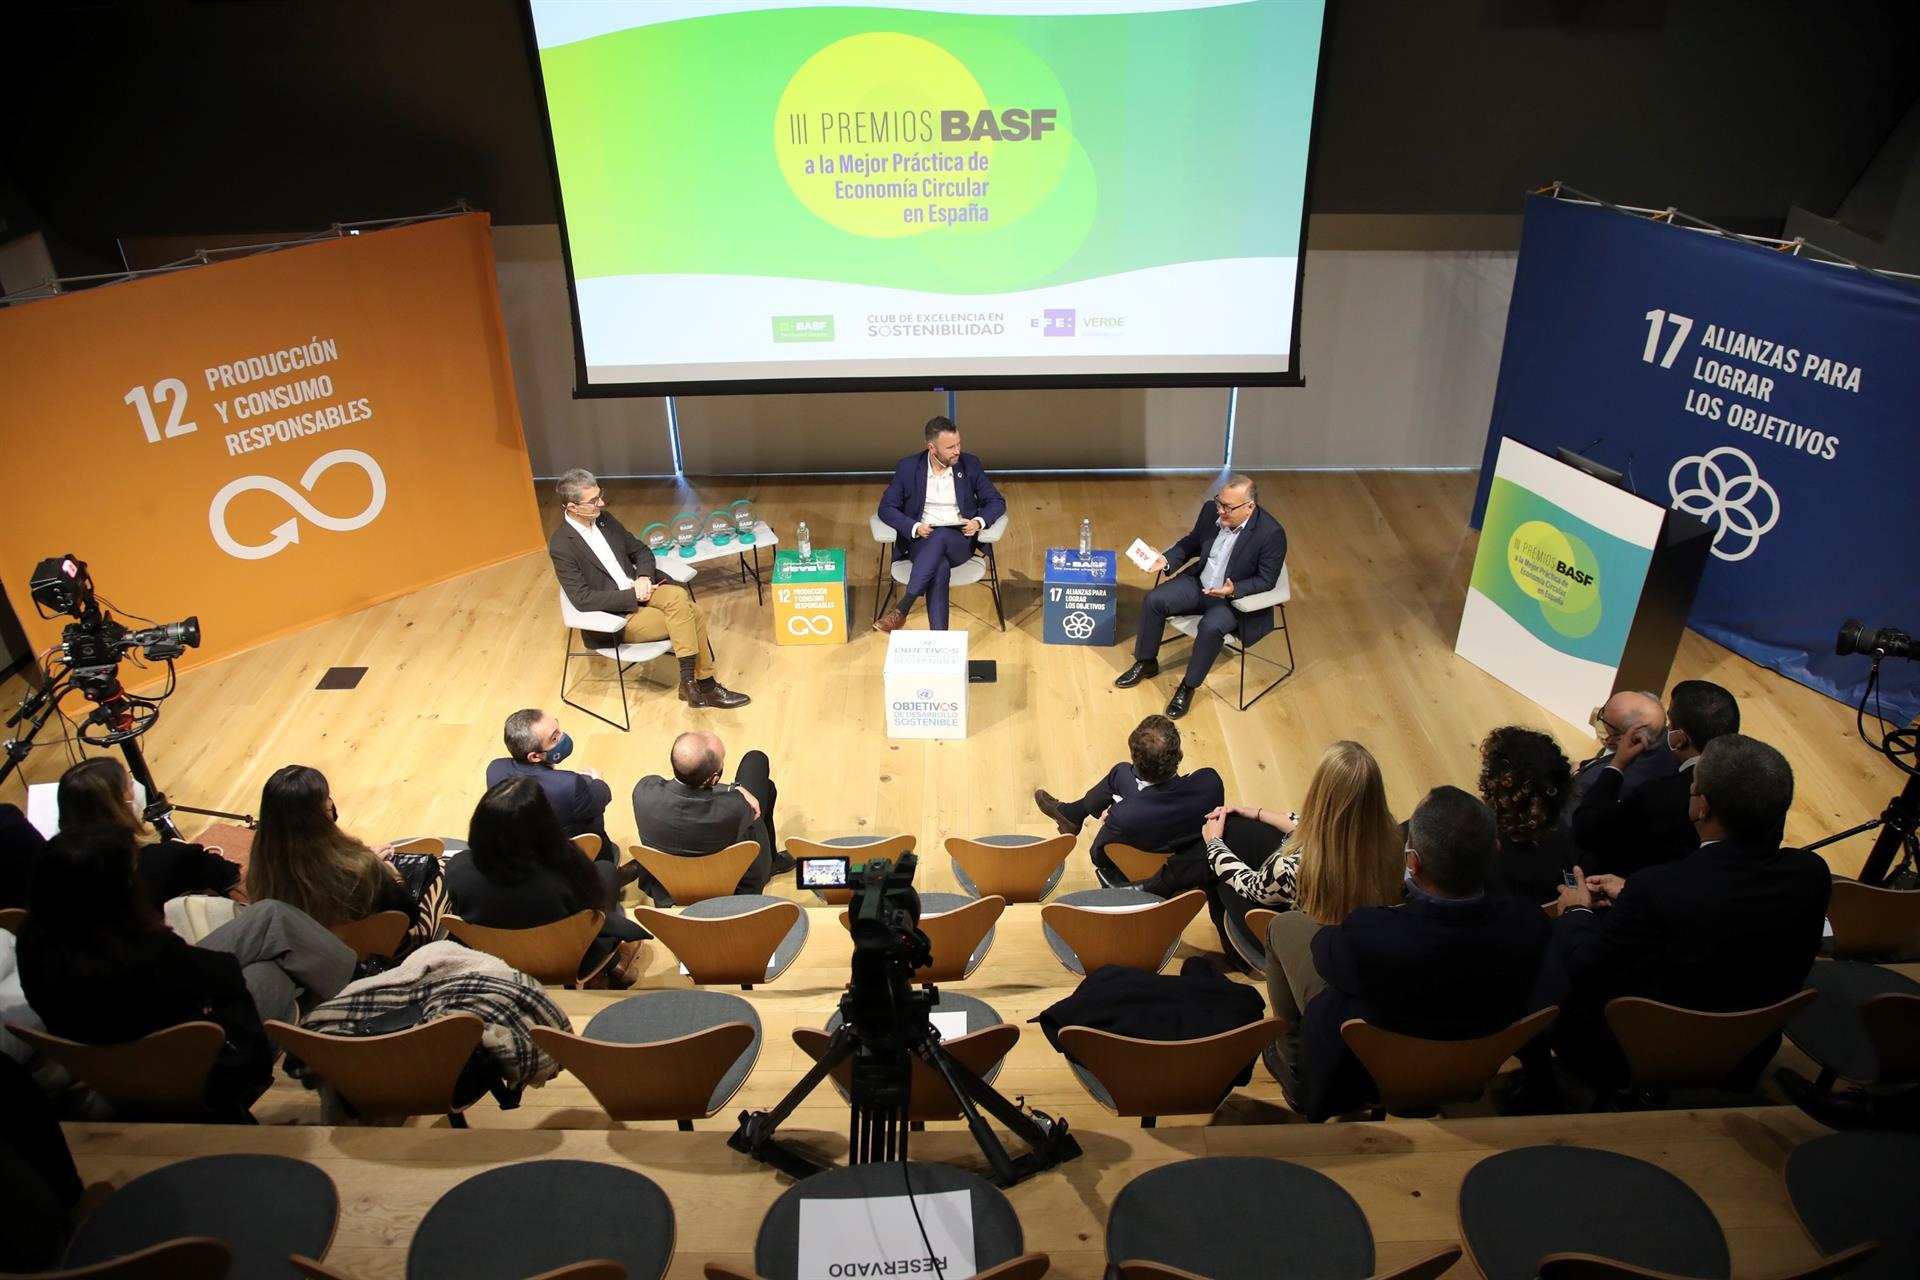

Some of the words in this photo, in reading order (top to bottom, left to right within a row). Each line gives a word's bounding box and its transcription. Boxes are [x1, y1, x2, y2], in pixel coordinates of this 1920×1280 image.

[790, 113, 808, 145] III
[822, 110, 933, 144] PREMIOS
[940, 108, 1057, 142] BASF
[805, 158, 815, 174] a
[819, 154, 835, 174] la
[838, 153, 889, 178] Mejor
[892, 151, 964, 173] Práctica
[968, 150, 989, 172] de
[834, 177, 918, 200] Economía
[922, 177, 990, 198] Circular
[903, 206, 924, 223] en
[928, 203, 989, 226] España
[795, 321, 828, 331] BASF
[867, 314, 896, 323] CLUB
[899, 314, 913, 323] DE
[916, 313, 986, 323] EXCELENCIA
[988, 312, 1004, 321] EN
[1082, 317, 1126, 328] VERDE
[867, 323, 1005, 337] SOSTENIBILIDAD
[1642, 308, 1693, 369] 17
[205, 336, 338, 391] PRODUCCIÓN
[1701, 324, 1800, 374] ALIANZAS
[1802, 353, 1862, 393] PARA
[1693, 356, 1774, 403] LOGRAR
[124, 377, 198, 443] 12
[213, 401, 229, 424] Y
[233, 375, 333, 420] CONSUMO
[224, 398, 373, 456] RESPONSABLES
[1684, 388, 1724, 421] LOS
[1726, 403, 1840, 460] OBJETIVOS
[1522, 541, 1557, 570] PREMIOS
[1556, 560, 1594, 586] BASF
[777, 589, 791, 603] 12
[1049, 587, 1063, 602] 17
[1065, 588, 1092, 596] ALIANZAS
[1092, 589, 1107, 597] PARA
[1065, 595, 1087, 603] LOGRAR
[1065, 602, 1076, 610] LOS
[1076, 602, 1106, 611] OBJETIVOS
[892, 701, 958, 711] OBJETIVOS
[894, 718, 959, 726] SOSTENIBLE
[828, 1256, 948, 1278] RESERVADO
